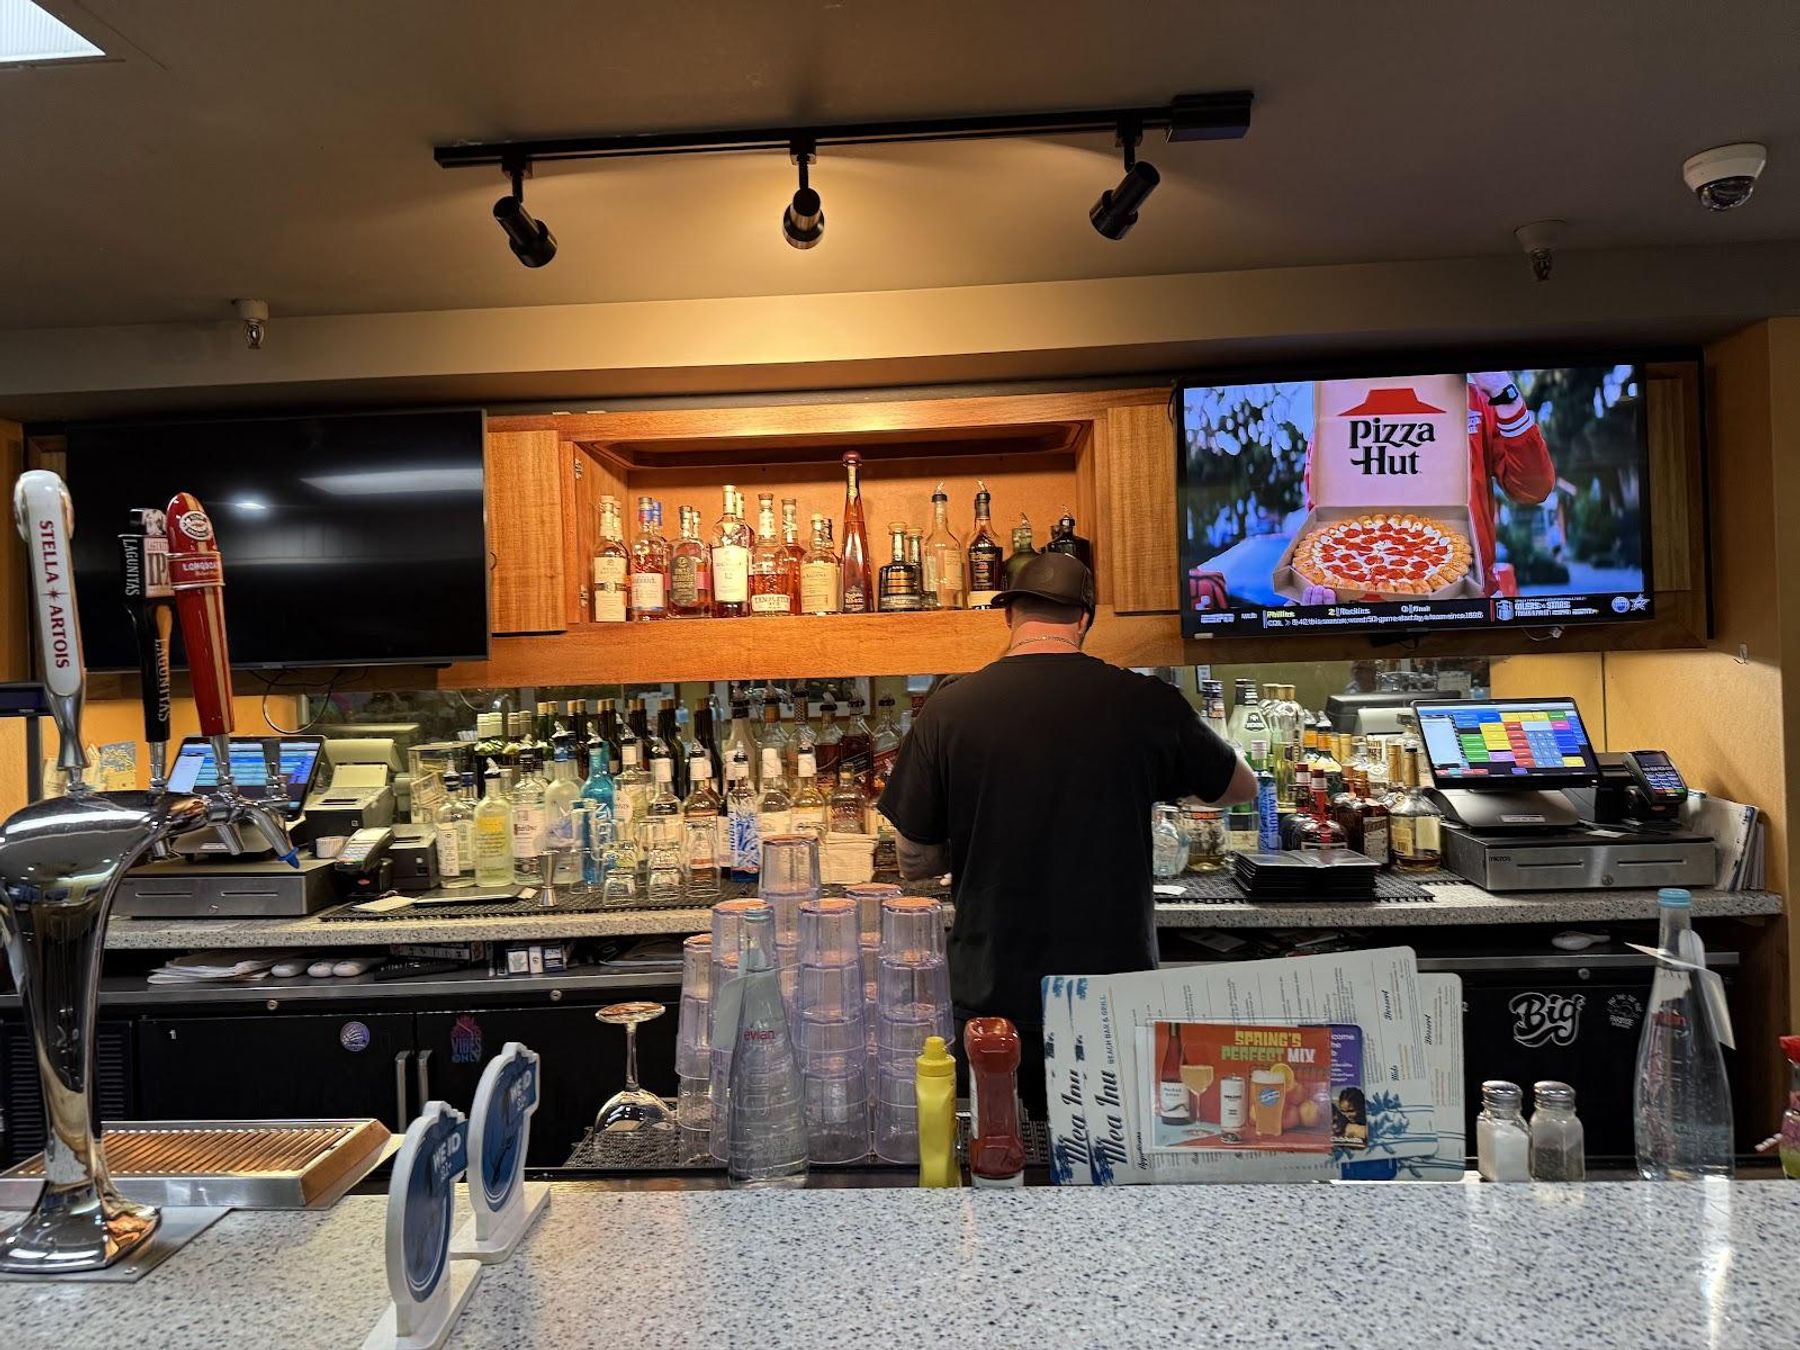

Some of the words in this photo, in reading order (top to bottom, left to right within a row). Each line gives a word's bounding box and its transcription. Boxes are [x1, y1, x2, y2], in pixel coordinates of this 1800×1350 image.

[1349, 417, 1436, 449] Pizza
[1350, 445, 1420, 475] Hut
[39, 520, 60, 584] STELLA
[122, 539, 140, 596] LAGUNITAS
[146, 552, 170, 586] IP
[1266, 610, 1295, 618] Phillies
[1328, 608, 1336, 616] 2
[1340, 607, 1371, 616] Rockies
[48, 605, 71, 669] ARTOIS
[154, 638, 171, 721] LAGUNITAS
[743, 1029, 775, 1041] evian
[1508, 991, 1587, 1048] Big
[1220, 1045, 1285, 1062] PERFECT
[1287, 1047, 1317, 1063] MIX
[1234, 1030, 1302, 1048] SPRING'S
[1094, 1069, 1121, 1107] Inn
[1095, 1114, 1128, 1165] Mea
